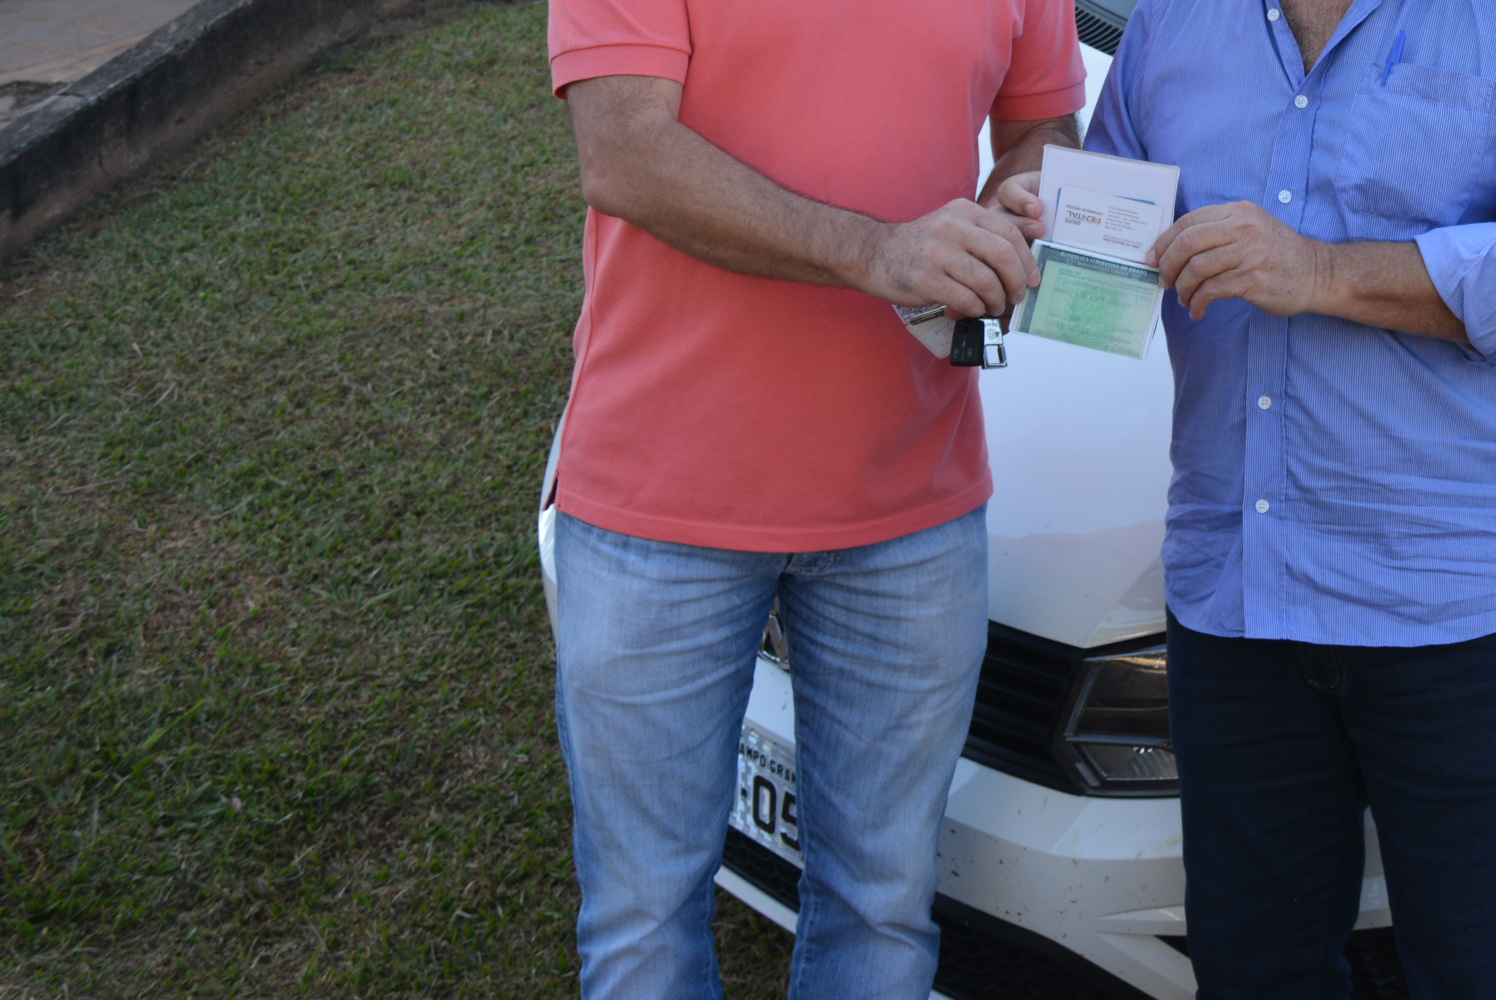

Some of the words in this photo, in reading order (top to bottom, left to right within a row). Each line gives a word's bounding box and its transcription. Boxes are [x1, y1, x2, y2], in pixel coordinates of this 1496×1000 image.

[1066, 210, 1102, 225] RENTAL
[739, 743, 766, 768] AMPO
[769, 760, 796, 783] GRAN
[753, 775, 801, 851] 05
